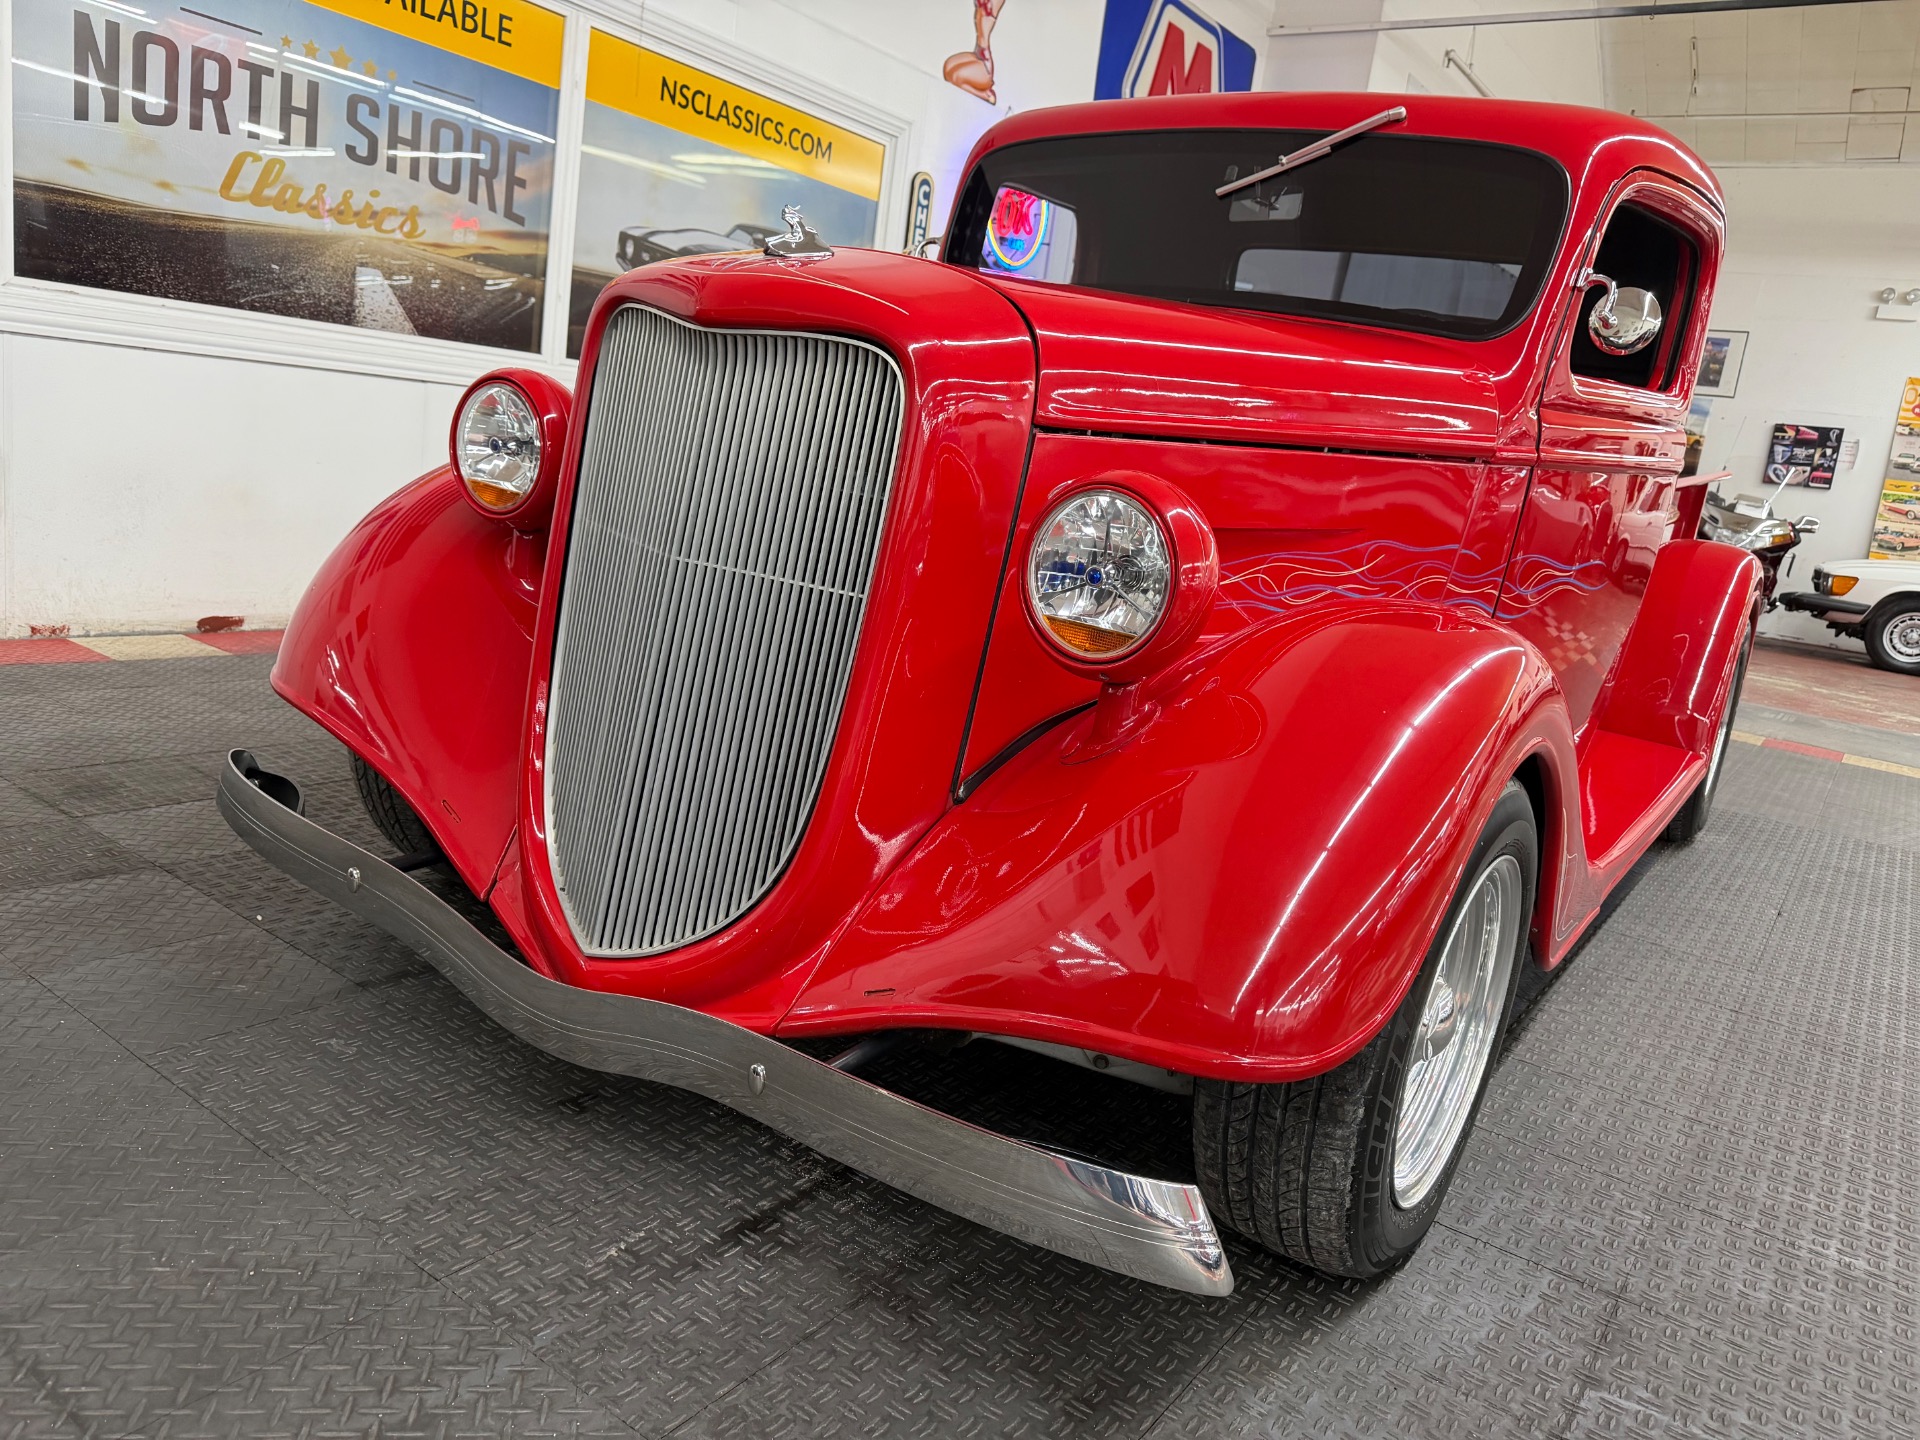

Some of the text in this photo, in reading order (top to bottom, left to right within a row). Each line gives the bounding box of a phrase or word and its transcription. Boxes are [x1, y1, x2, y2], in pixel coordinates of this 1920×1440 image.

[384, 0, 512, 47] LABLE
[73, 9, 530, 227] NORTH SHORE
[660, 76, 832, 163] NSCLASSICS.COM
[218, 151, 426, 239] Classics
